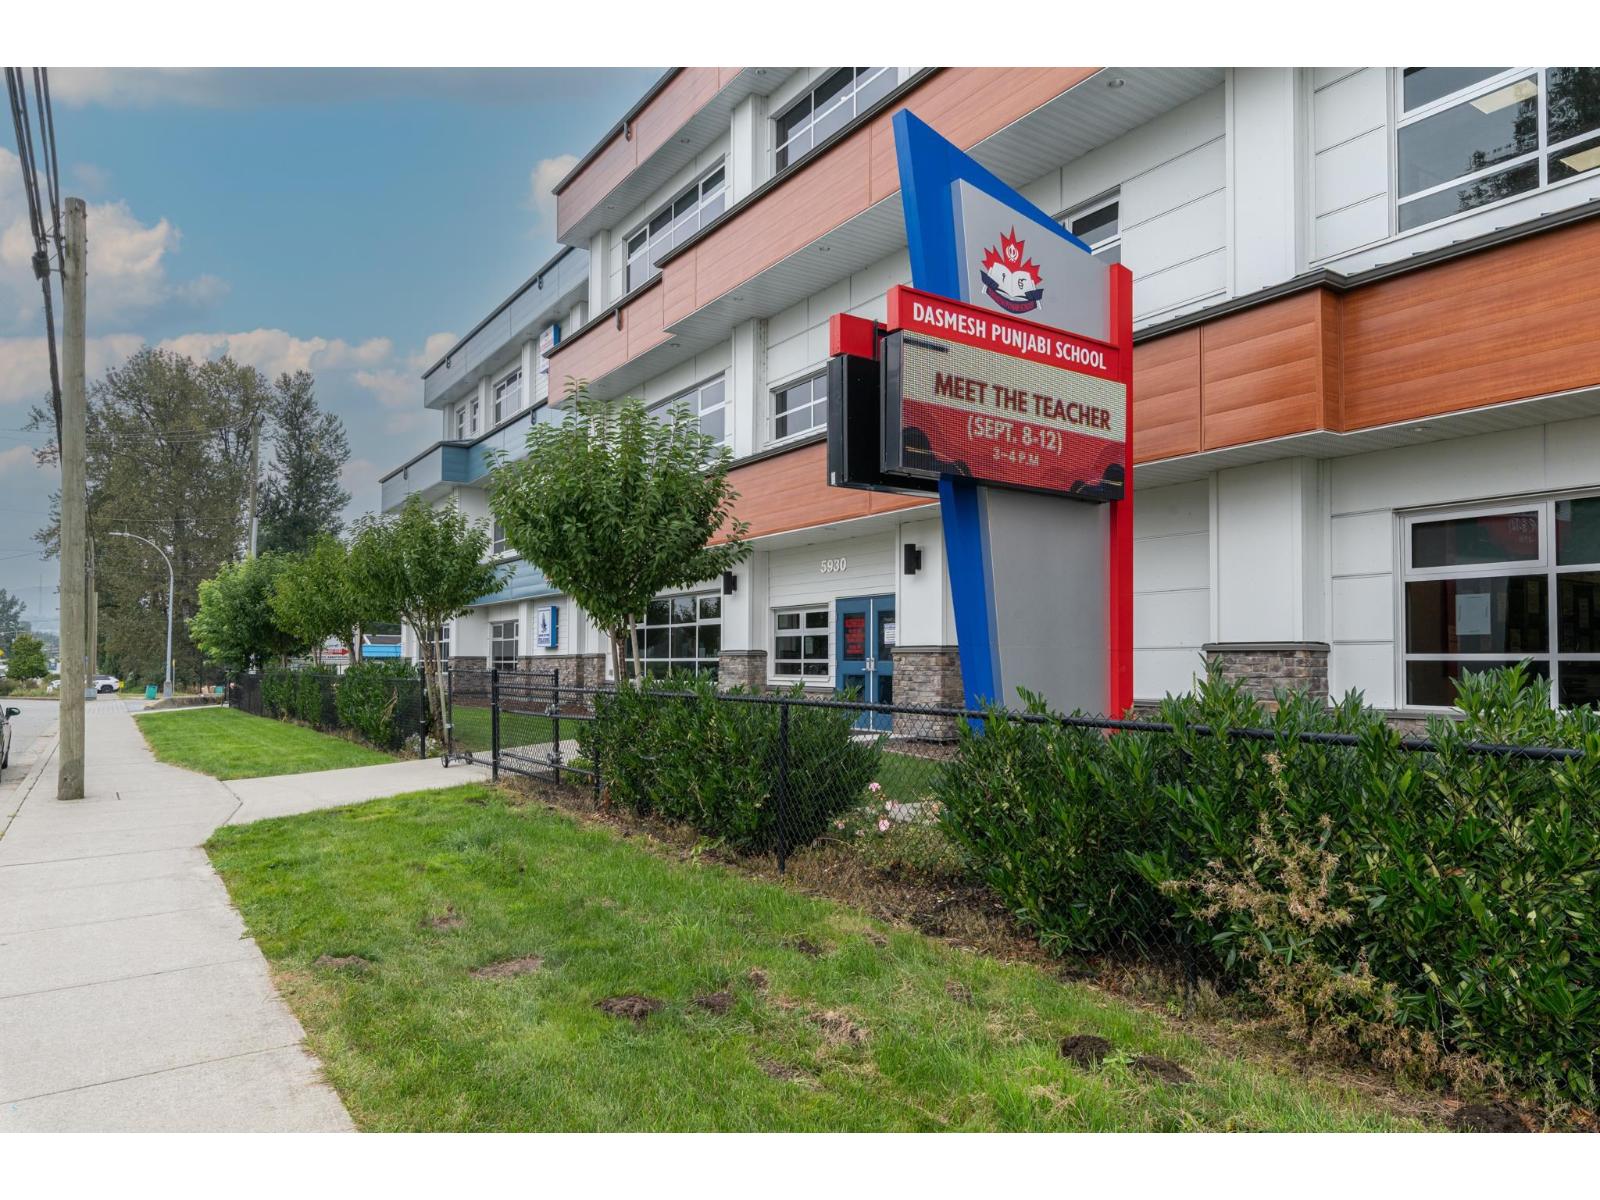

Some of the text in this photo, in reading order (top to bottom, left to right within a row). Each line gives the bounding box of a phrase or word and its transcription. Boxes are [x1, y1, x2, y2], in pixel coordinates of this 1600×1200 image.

[913, 302, 1107, 370] DASMESH PUNJABI SCHOOL
[934, 371, 1111, 431] MEET THE TEACHER
[967, 415, 1063, 456] (SEPT. 8-12)
[820, 557, 847, 573] 5930
